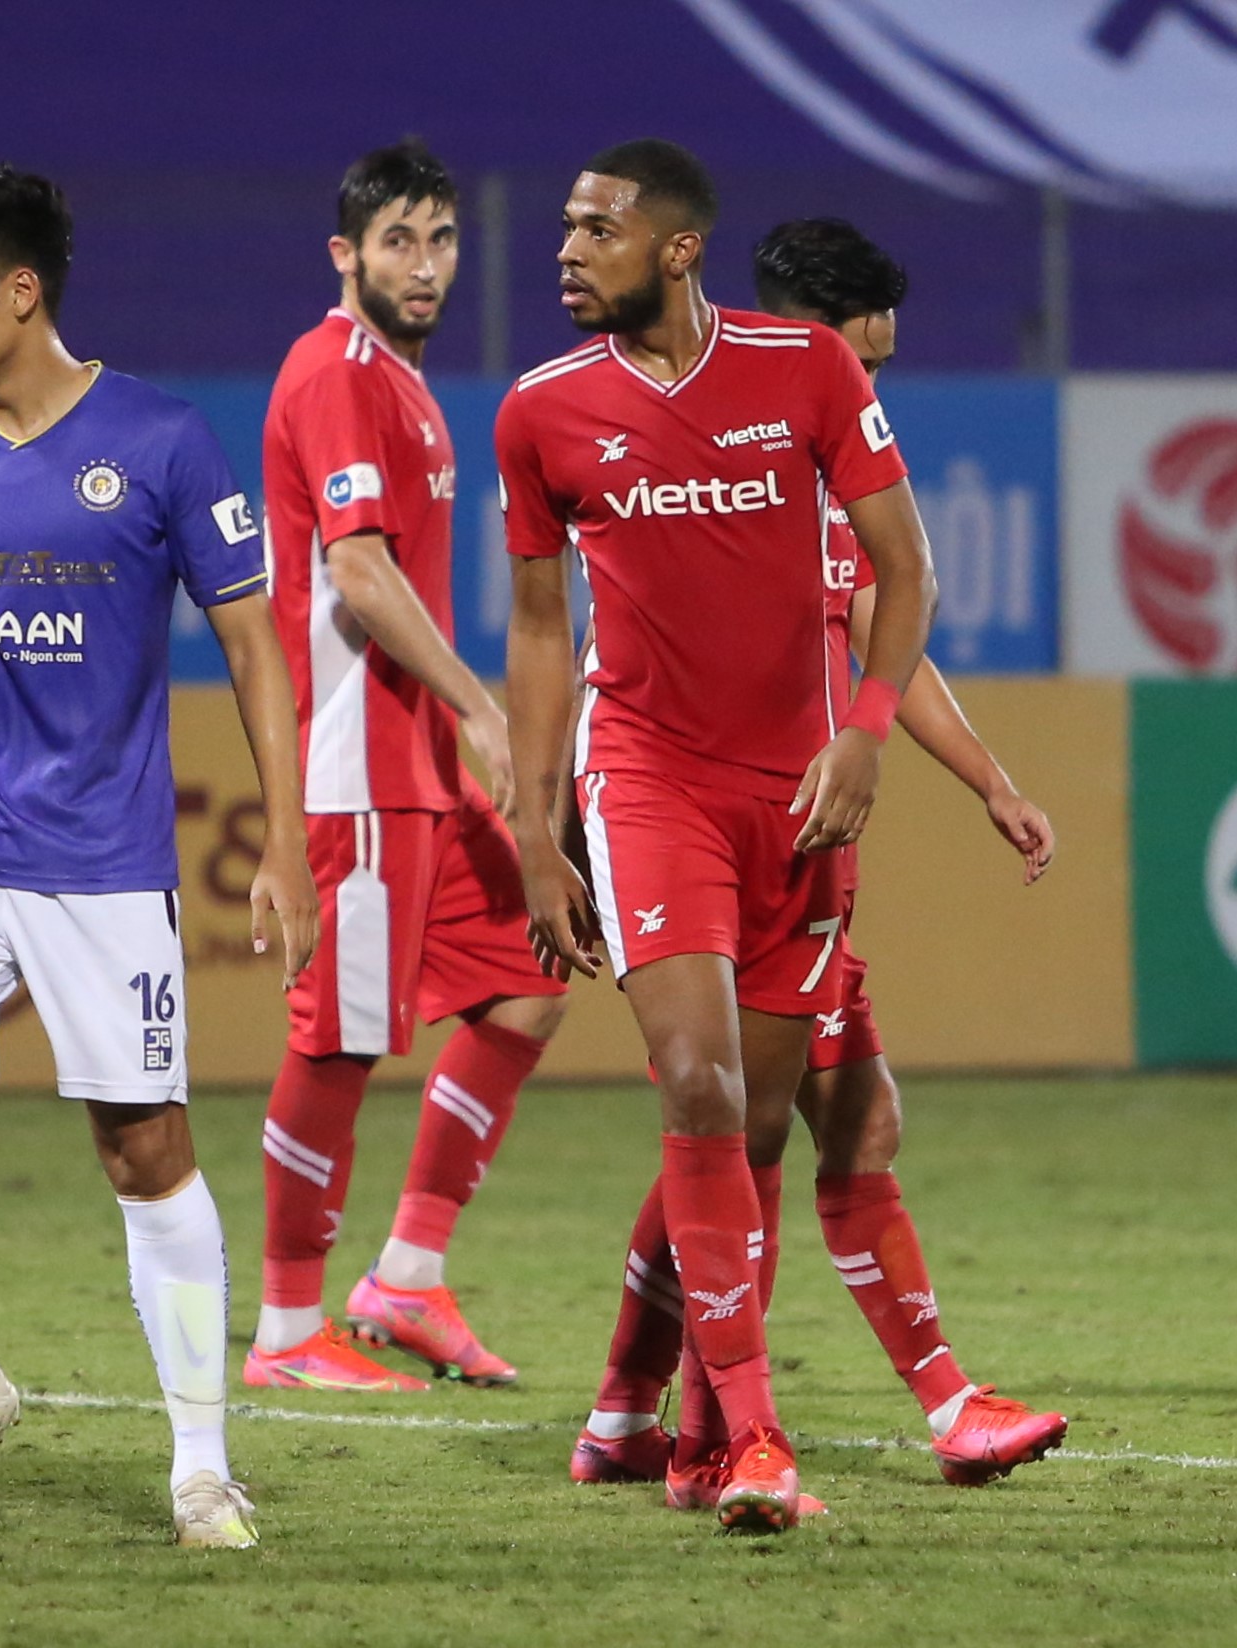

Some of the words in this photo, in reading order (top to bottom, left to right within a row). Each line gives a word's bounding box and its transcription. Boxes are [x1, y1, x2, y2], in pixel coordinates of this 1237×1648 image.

[713, 419, 791, 449] viettel
[761, 439, 793, 452] sports
[602, 469, 786, 520] viettel
[19, 650, 54, 664] Ngon
[798, 915, 841, 993] 7
[127, 971, 176, 1023] 16
[146, 1030, 171, 1049] JG
[146, 1050, 171, 1068] BL
